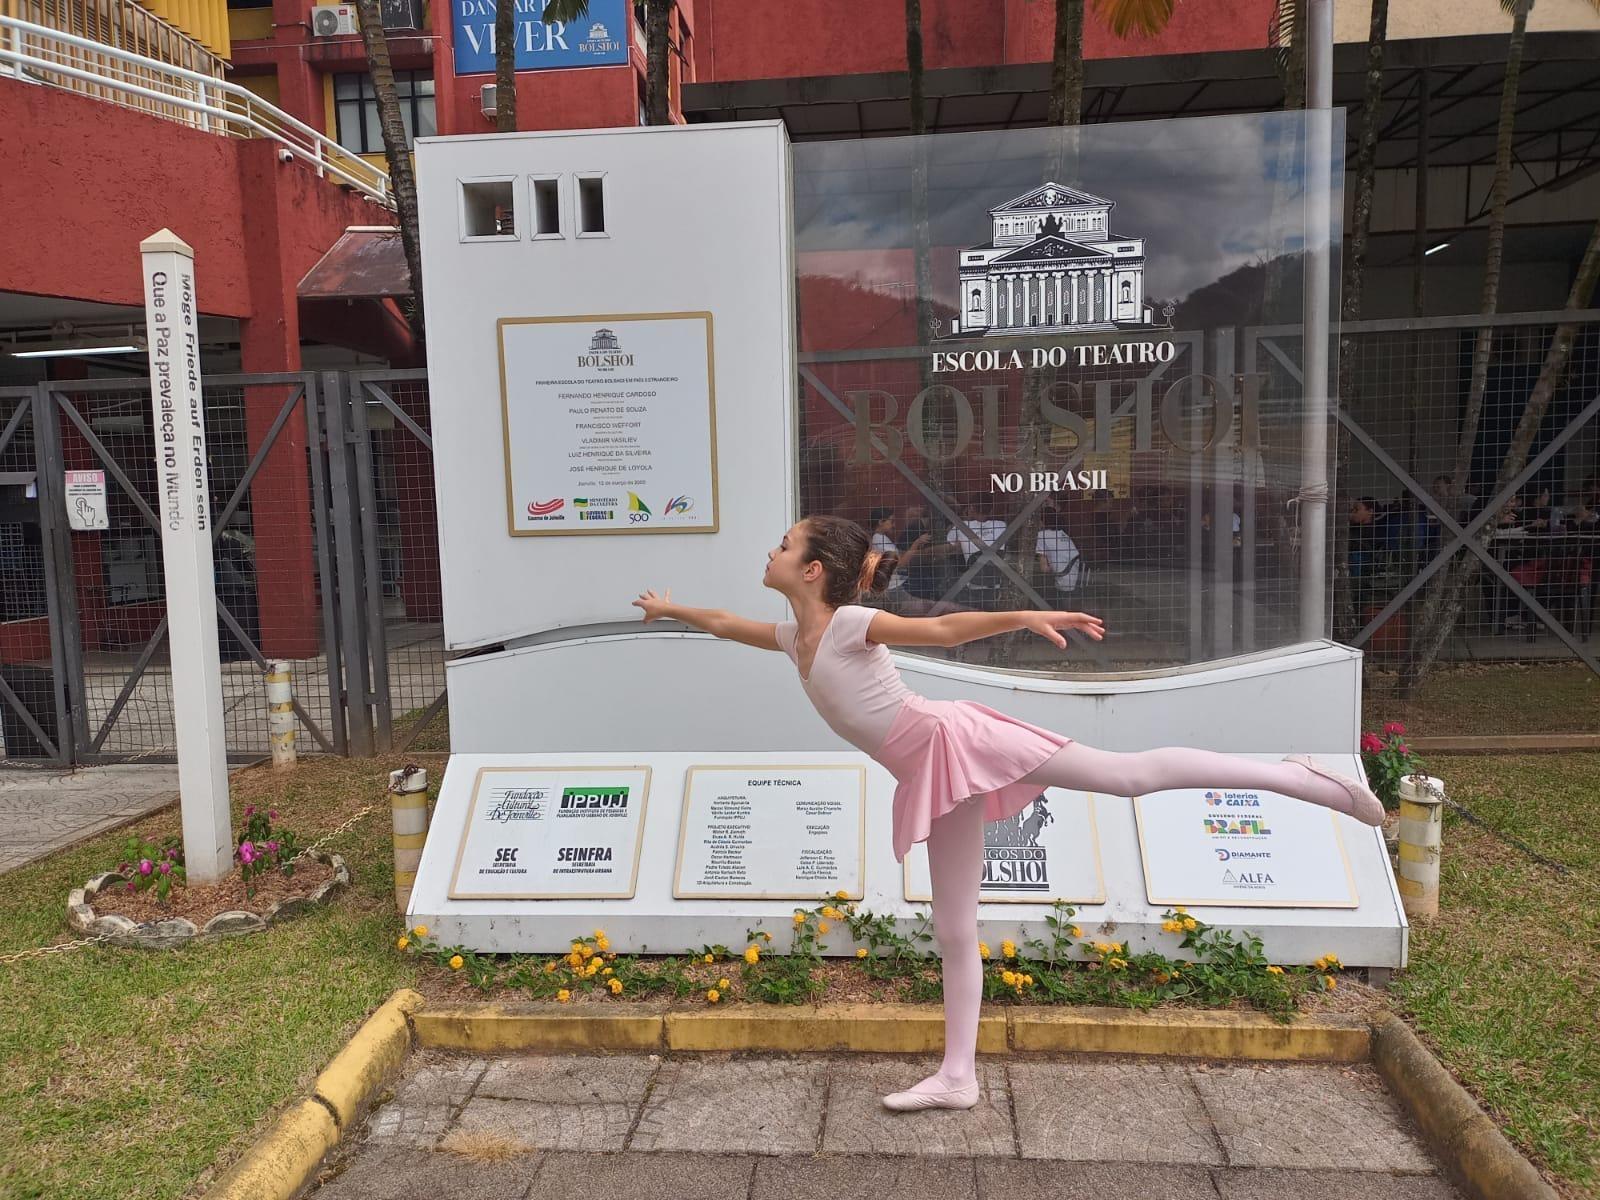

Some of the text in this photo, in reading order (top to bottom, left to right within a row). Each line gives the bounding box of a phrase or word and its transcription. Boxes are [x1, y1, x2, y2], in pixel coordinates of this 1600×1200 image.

[461, 0, 536, 17] DANAR
[578, 42, 620, 52] BOLSHOI
[577, 354, 634, 367] BOLSHOI
[932, 341, 1176, 373] ESCOLA DO TEATRO
[152, 271, 184, 531] Que a Paz prevaleça no Mundo
[181, 273, 207, 531] Möge Friede auf Erden sein
[845, 372, 1269, 466] BOLSHOI
[72, 473, 98, 483] AVISO
[990, 473, 1024, 493] NO
[629, 513, 649, 525] 500
[504, 789, 544, 800] Fundação
[1203, 819, 1271, 834] BRASIL
[494, 847, 519, 862] SEC
[557, 847, 612, 862] SEINFRA
[984, 849, 1044, 860] IGOS DO
[982, 861, 1048, 882] LSHOI
[1239, 873, 1274, 883] ALFA
